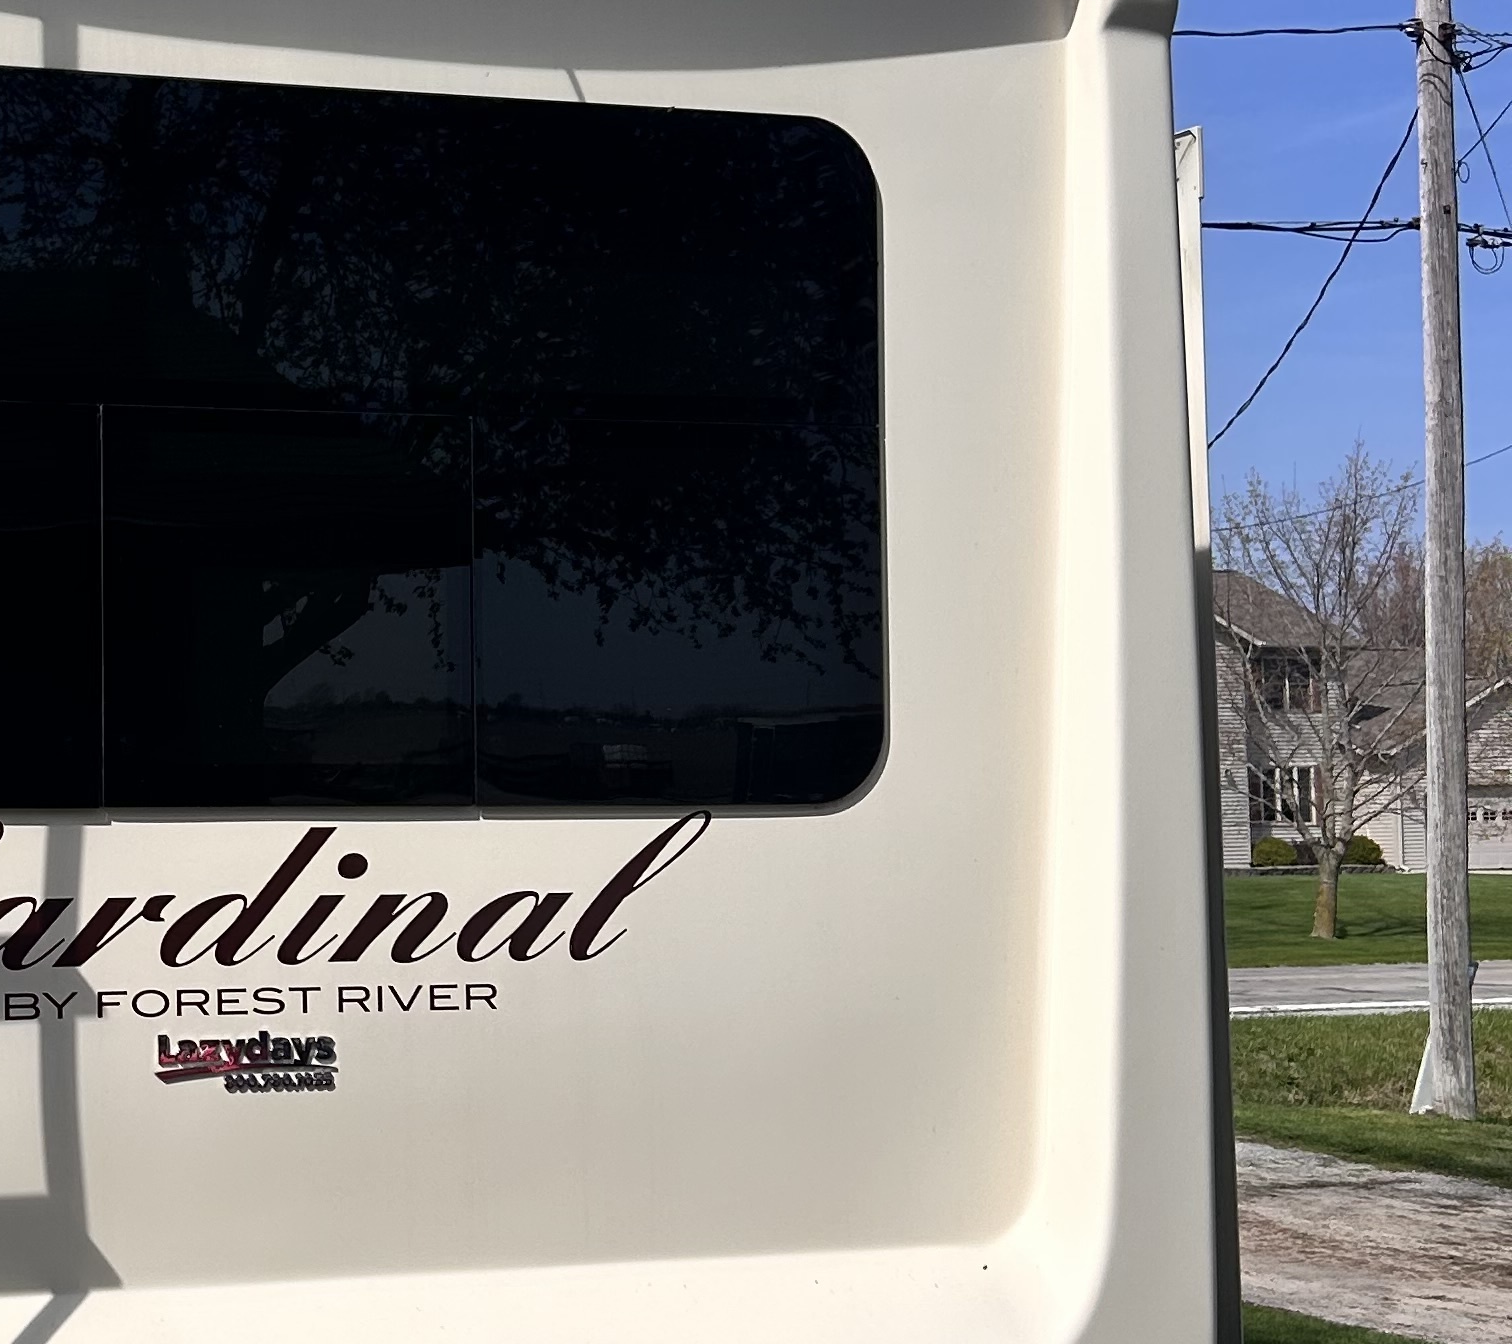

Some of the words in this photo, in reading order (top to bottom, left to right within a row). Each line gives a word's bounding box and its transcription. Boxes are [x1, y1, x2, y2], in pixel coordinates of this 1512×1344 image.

[4, 991, 78, 1021] BY
[97, 986, 321, 1018] FOREST
[338, 983, 498, 1013] RIVER
[158, 1031, 337, 1067] Lazydays
